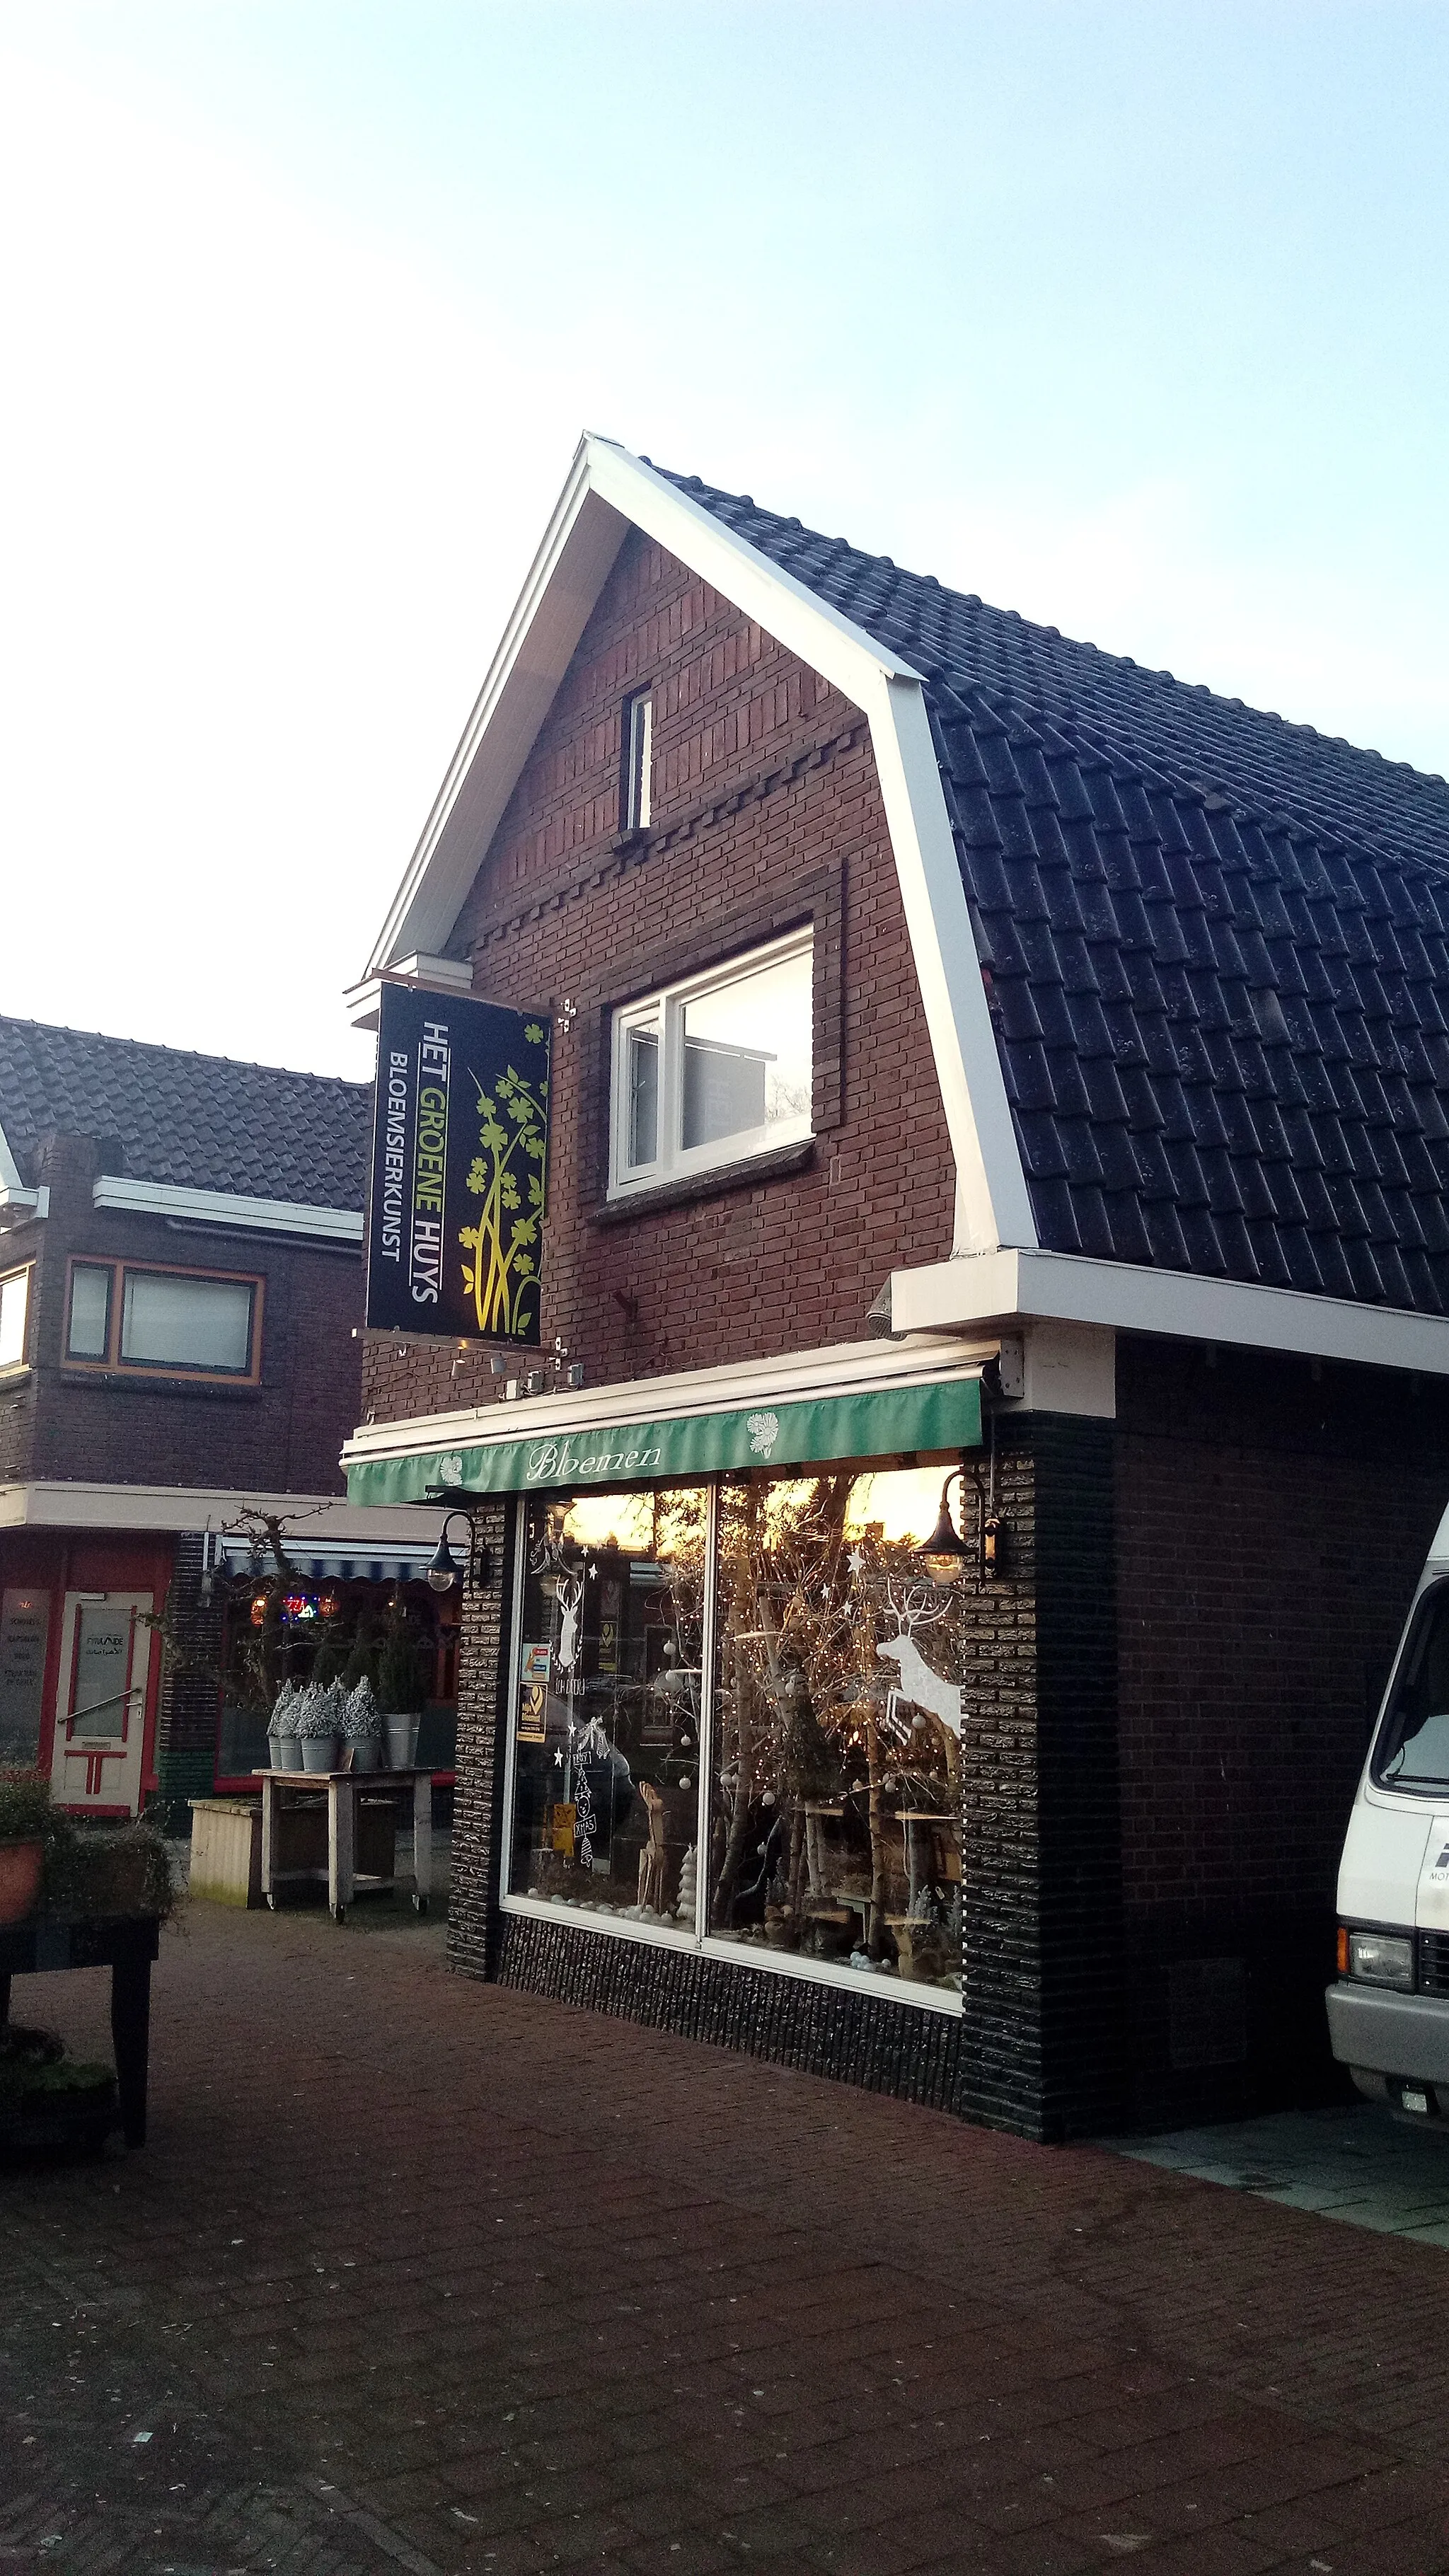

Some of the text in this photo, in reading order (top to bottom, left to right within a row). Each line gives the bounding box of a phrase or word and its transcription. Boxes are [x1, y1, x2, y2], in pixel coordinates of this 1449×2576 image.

[381, 1051, 408, 1262] BLOEMSIERKUNST
[412, 1022, 449, 1303] HET GROENE HUYS
[526, 1440, 661, 1481] Bloemen
[575, 1819, 594, 1836] XMAS
